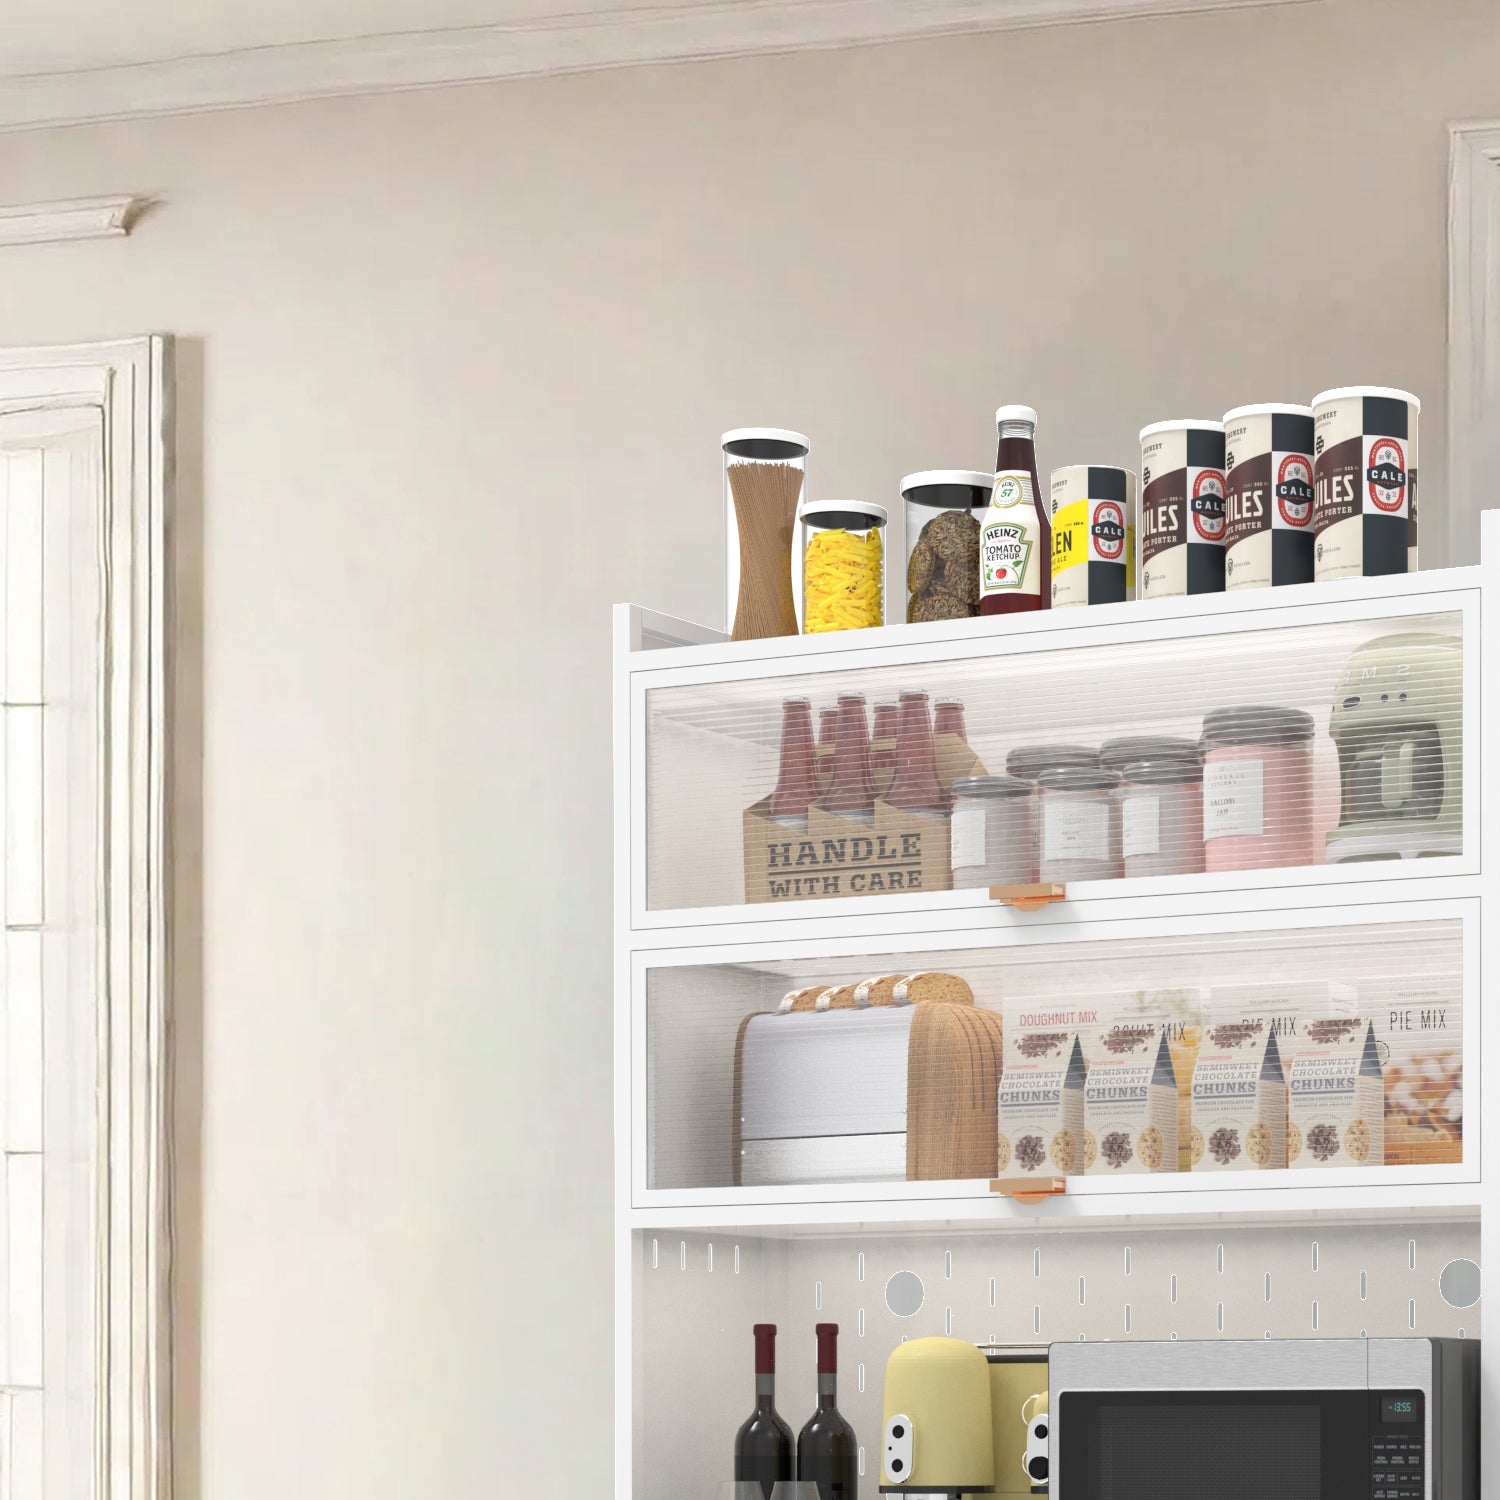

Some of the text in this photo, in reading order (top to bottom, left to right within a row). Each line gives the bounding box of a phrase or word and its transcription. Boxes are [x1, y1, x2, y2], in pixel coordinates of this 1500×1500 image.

[1371, 469, 1403, 482] CALE
[1000, 489, 1013, 498] 57
[1280, 485, 1312, 498] CALE
[1195, 500, 1226, 512] CALE
[1325, 506, 1353, 517] PORTER
[1095, 526, 1122, 536] CALE
[1234, 521, 1263, 532] PORTER
[986, 528, 1019, 540] HEINZ
[985, 544, 1022, 556] TOMATO
[986, 552, 1020, 562] KETCHUP
[767, 833, 922, 868] HANDLE
[769, 870, 922, 898] WITH CARE
[1019, 1011, 1098, 1027] DOUGHNUT MIX
[1390, 1009, 1446, 1031] PIE MIX
[1272, 1016, 1297, 1036] MIX
[1196, 1062, 1260, 1072] SEMISWEET
[1294, 1058, 1359, 1068] SEMISWEET
[1003, 1071, 1064, 1081] SEMISWEET
[1089, 1067, 1152, 1077] SEMISWEET
[1194, 1071, 1258, 1081] CHOCOLATE
[1292, 1067, 1356, 1077] CHOCOLATE
[1001, 1080, 1061, 1089] CHOCOLATE
[1087, 1076, 1149, 1086] CHOCOLATE
[1291, 1077, 1356, 1091] CHUNKS
[1086, 1086, 1148, 1099] CHUNKS
[1193, 1081, 1257, 1095] CHUNKS
[1000, 1089, 1060, 1103] CHUNKS
